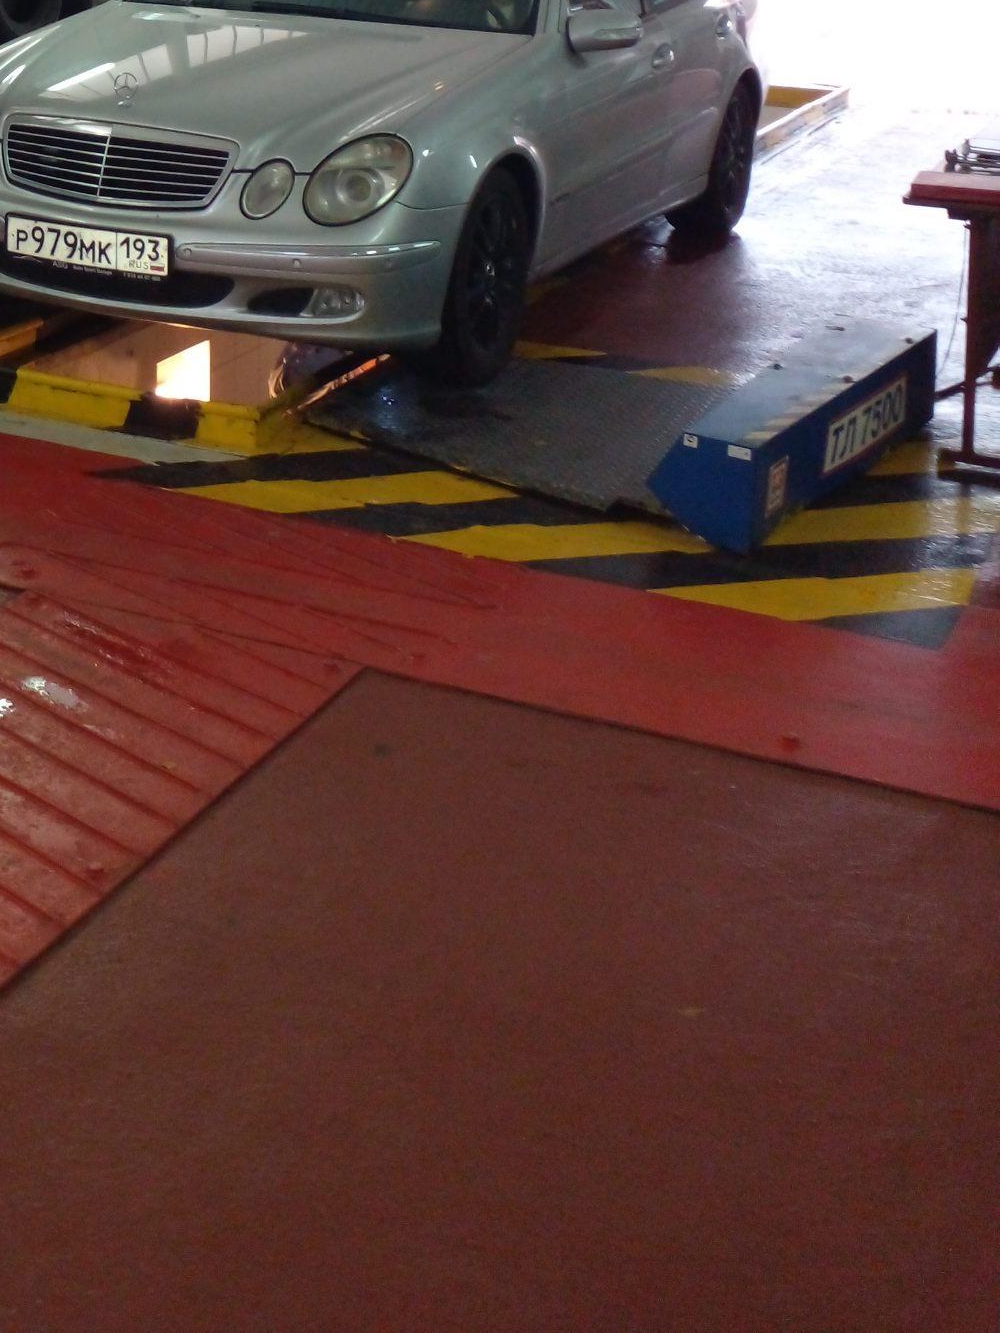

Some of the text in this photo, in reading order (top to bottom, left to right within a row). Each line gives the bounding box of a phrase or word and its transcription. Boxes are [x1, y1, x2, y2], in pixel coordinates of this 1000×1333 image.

[16, 226, 160, 265] Р979МК 193
[128, 260, 149, 270] RUS
[861, 383, 904, 445] 7500
